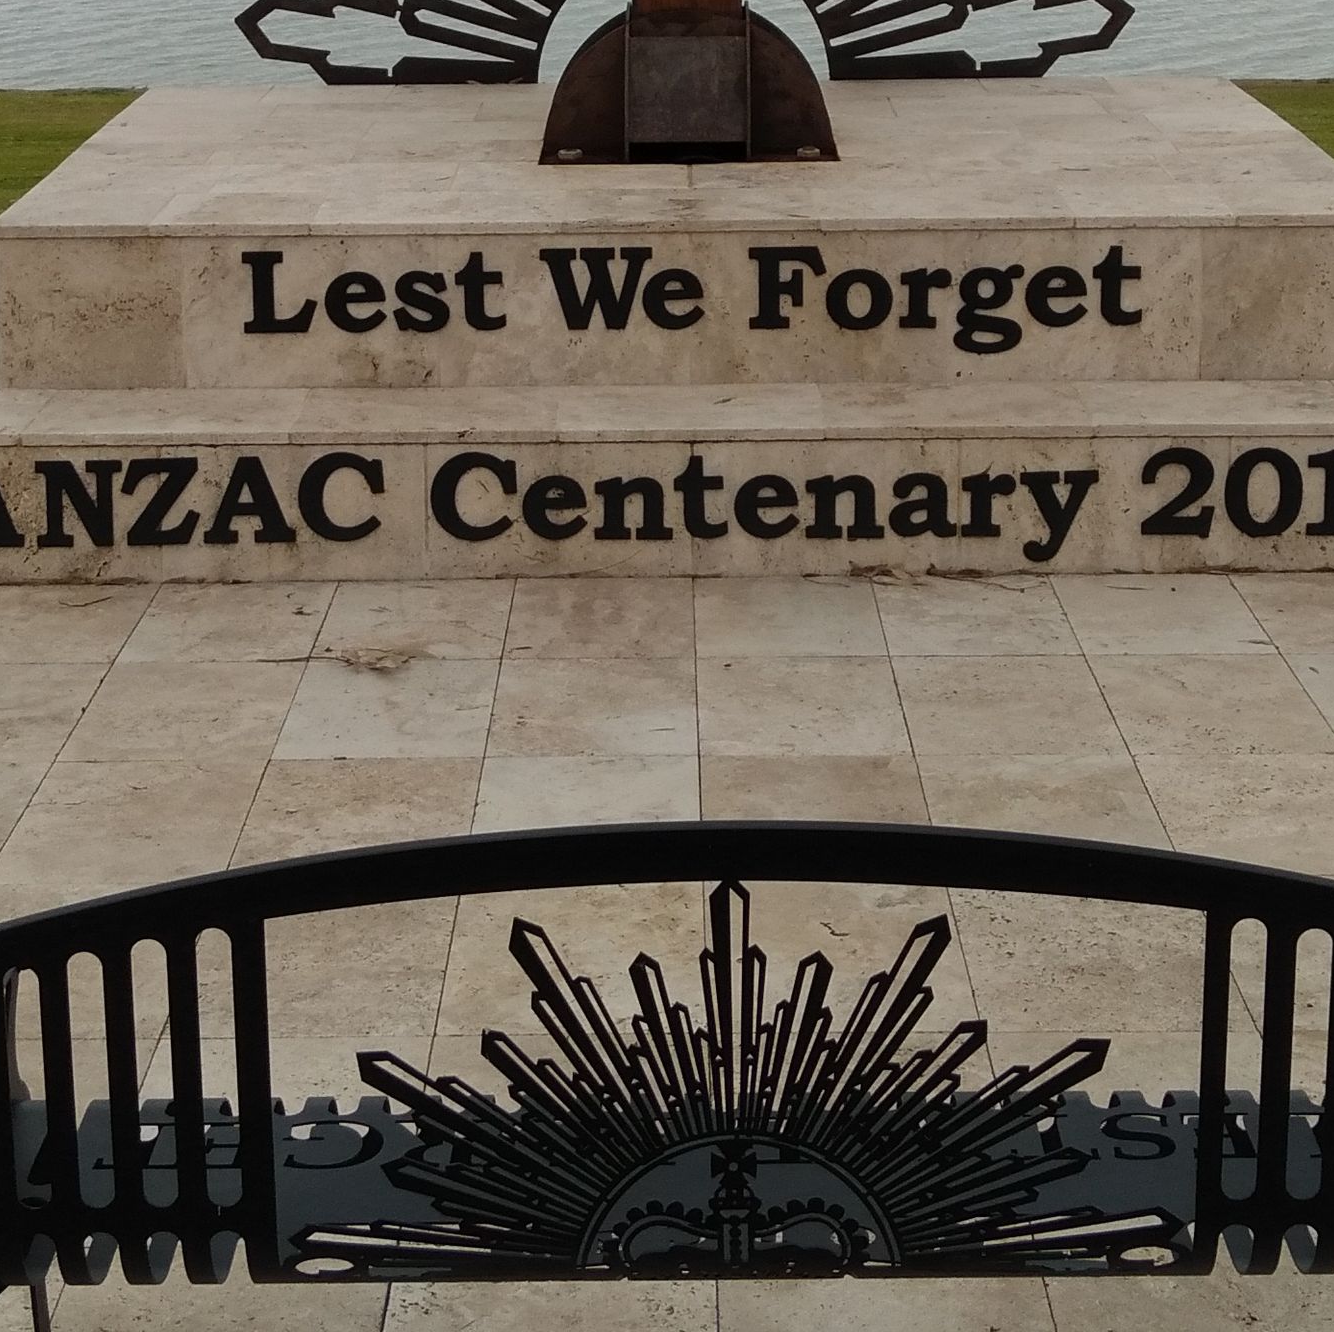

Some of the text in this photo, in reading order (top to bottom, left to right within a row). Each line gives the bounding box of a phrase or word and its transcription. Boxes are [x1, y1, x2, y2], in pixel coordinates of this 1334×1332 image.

[241, 245, 1143, 357] Lest We Forget
[430, 451, 1100, 564] Centenary
